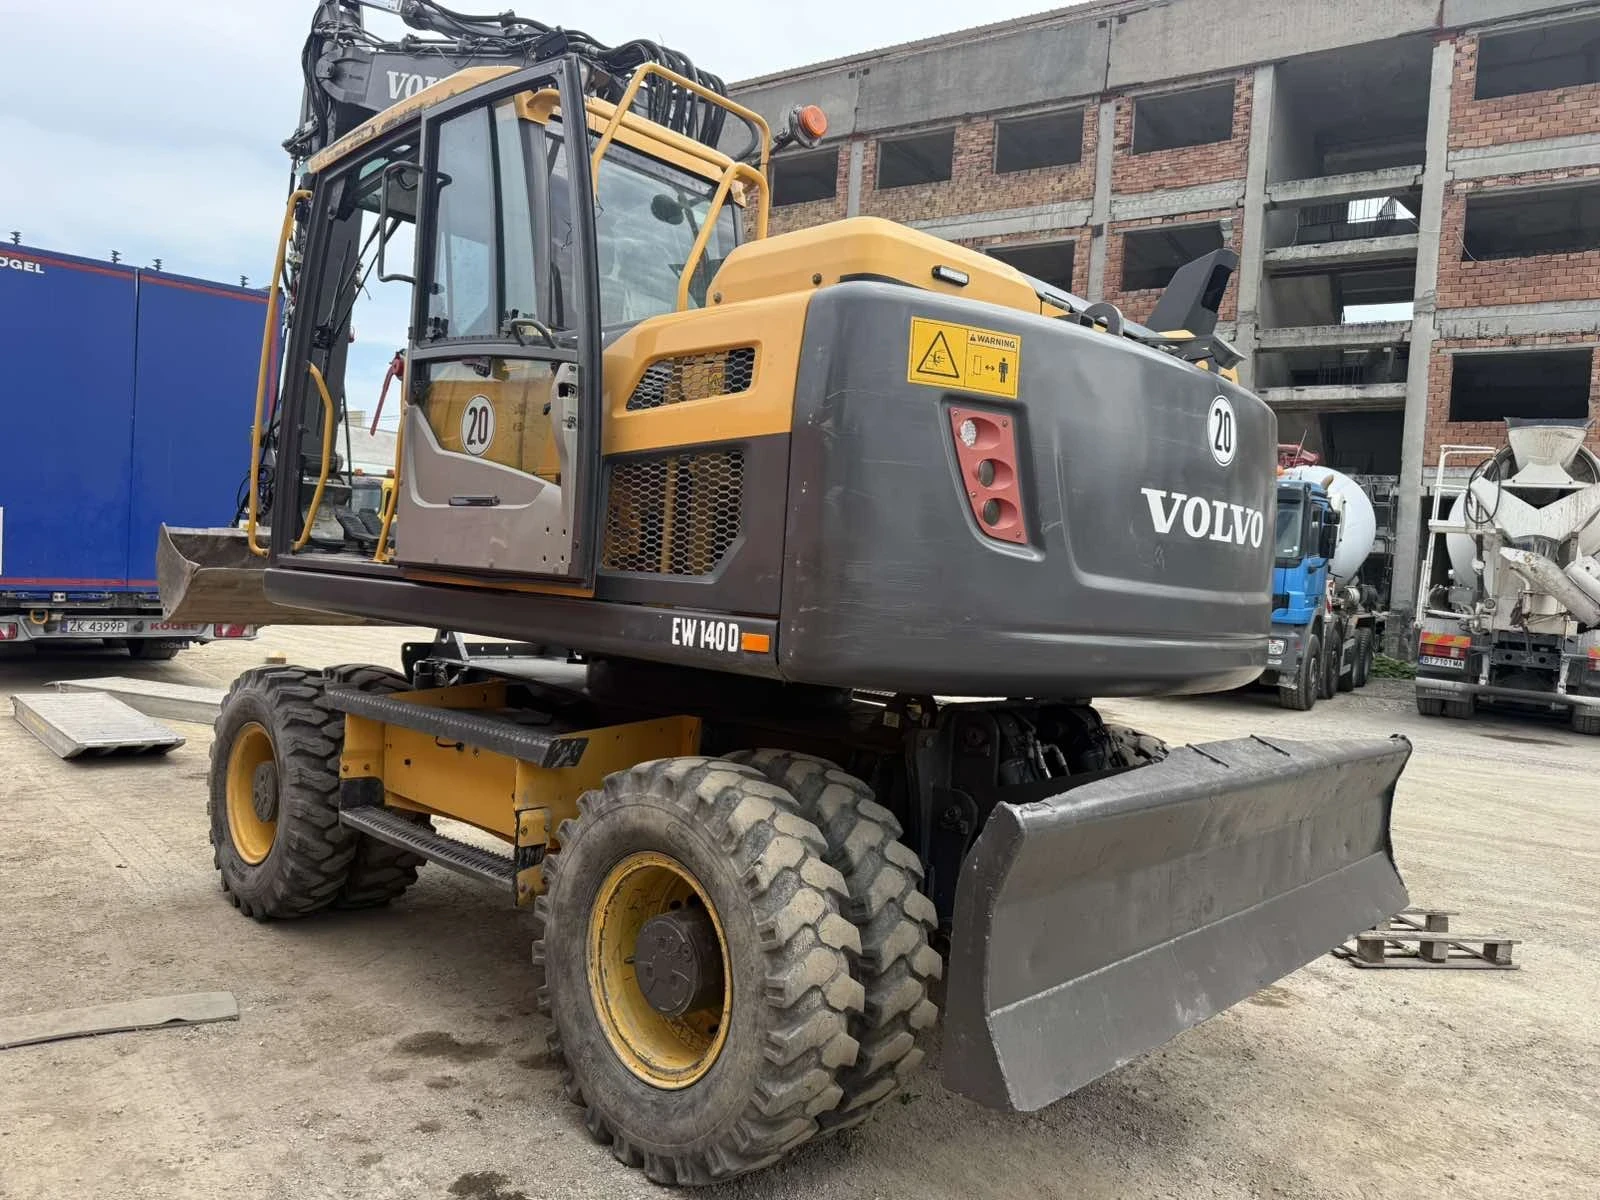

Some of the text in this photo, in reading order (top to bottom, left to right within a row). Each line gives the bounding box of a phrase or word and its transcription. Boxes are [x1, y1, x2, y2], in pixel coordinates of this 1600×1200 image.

[977, 335, 1015, 349] WARNING
[466, 406, 489, 445] 20
[1214, 408, 1232, 453] 20
[1141, 487, 1264, 548] VOLVO
[671, 617, 697, 647] EW
